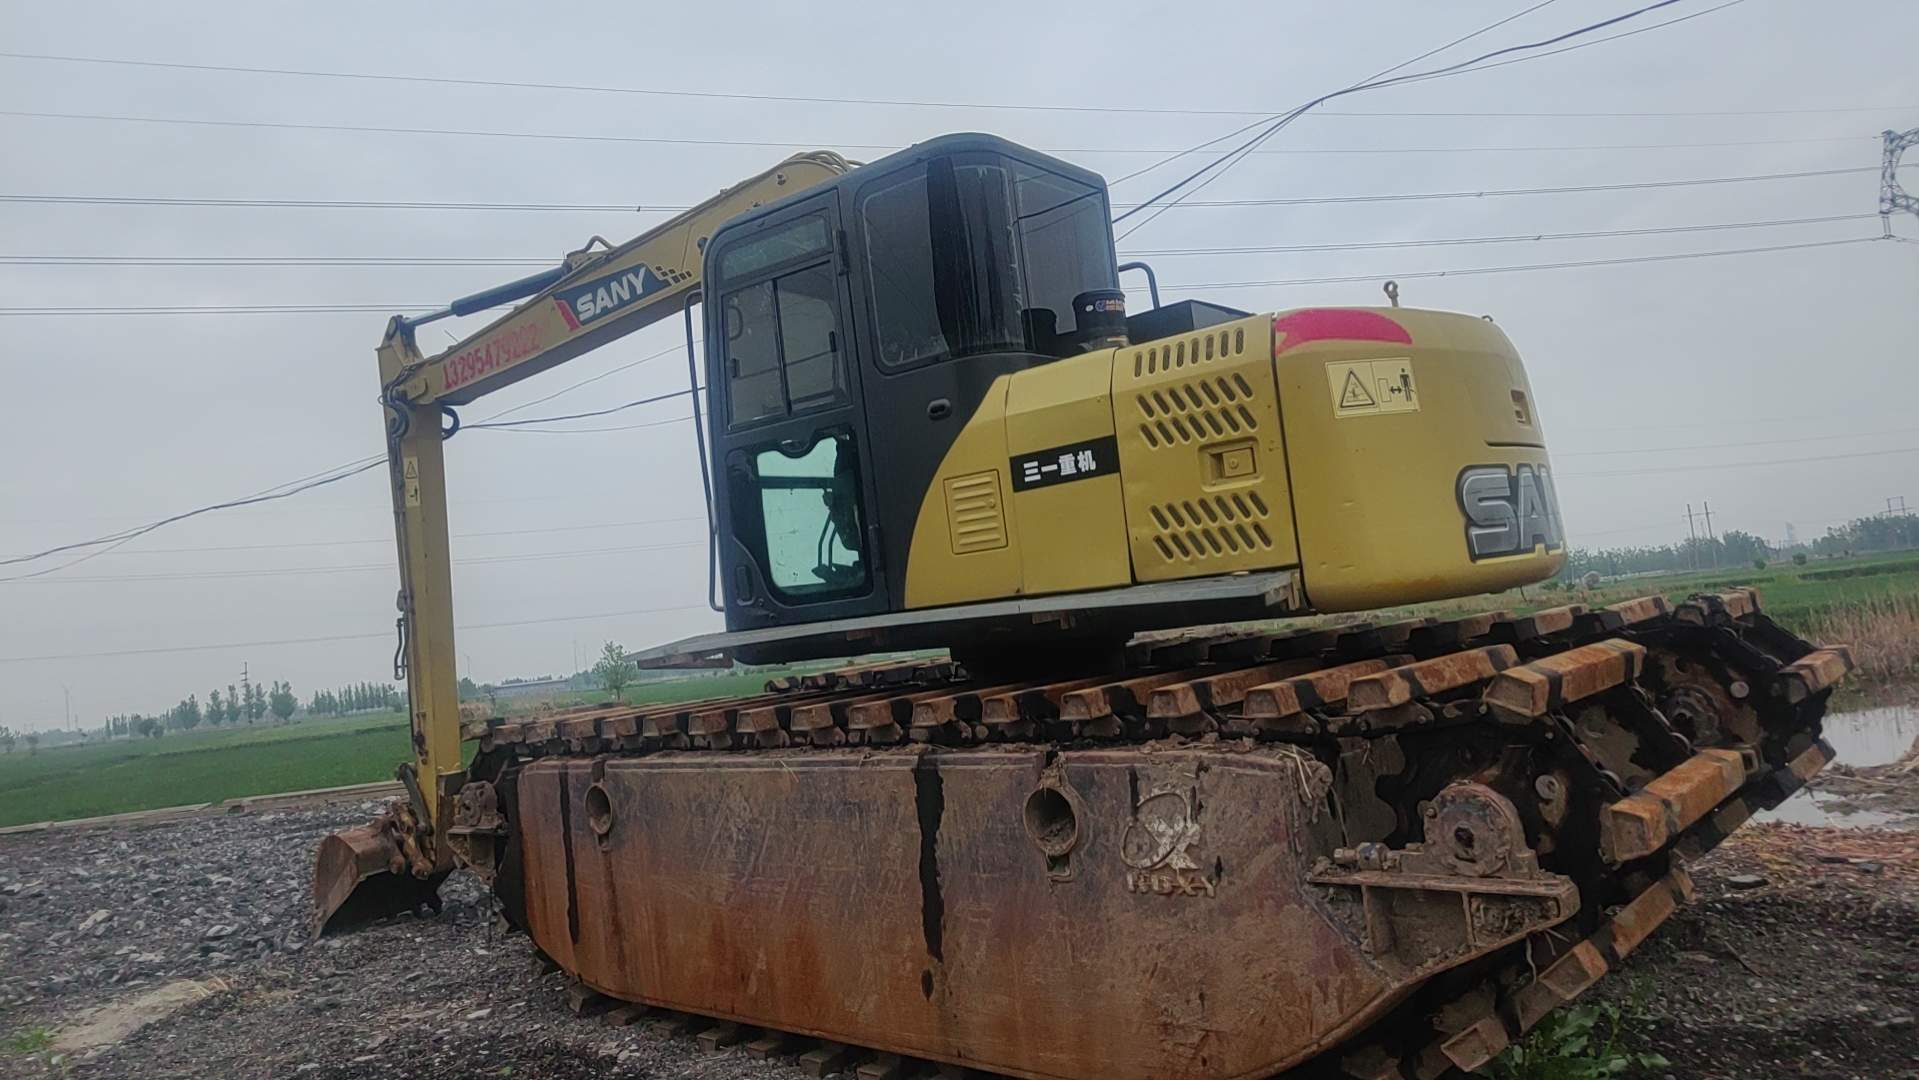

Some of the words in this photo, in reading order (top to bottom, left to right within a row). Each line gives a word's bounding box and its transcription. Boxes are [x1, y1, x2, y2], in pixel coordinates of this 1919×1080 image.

[576, 266, 647, 321] SANY
[1023, 449, 1097, 483] 三一重机
